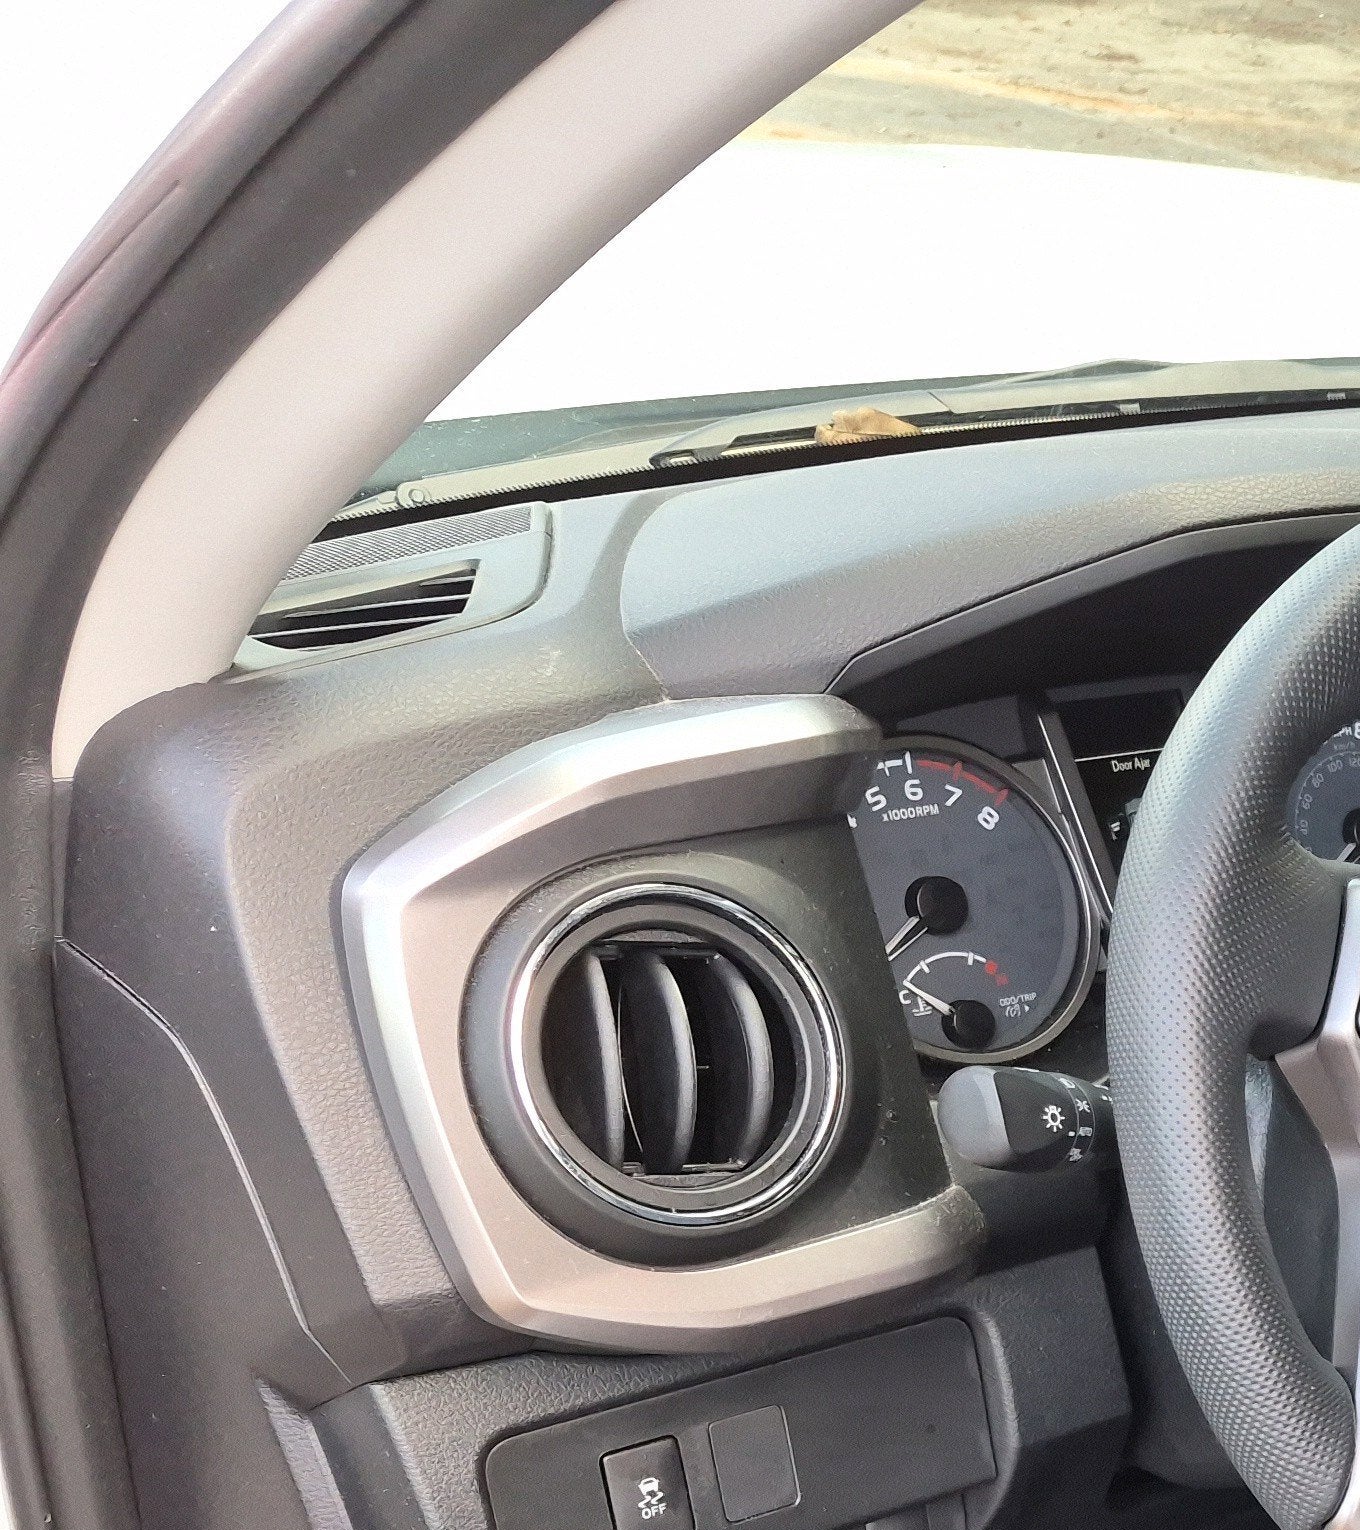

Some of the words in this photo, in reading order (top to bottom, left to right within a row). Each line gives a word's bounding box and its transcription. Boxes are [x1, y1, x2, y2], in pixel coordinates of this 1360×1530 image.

[1111, 759, 1133, 773] Door
[865, 785, 887, 812] 5
[904, 779, 924, 801] 6
[944, 784, 963, 807] 7
[977, 805, 1000, 831] 8
[641, 1503, 667, 1520] OFF
